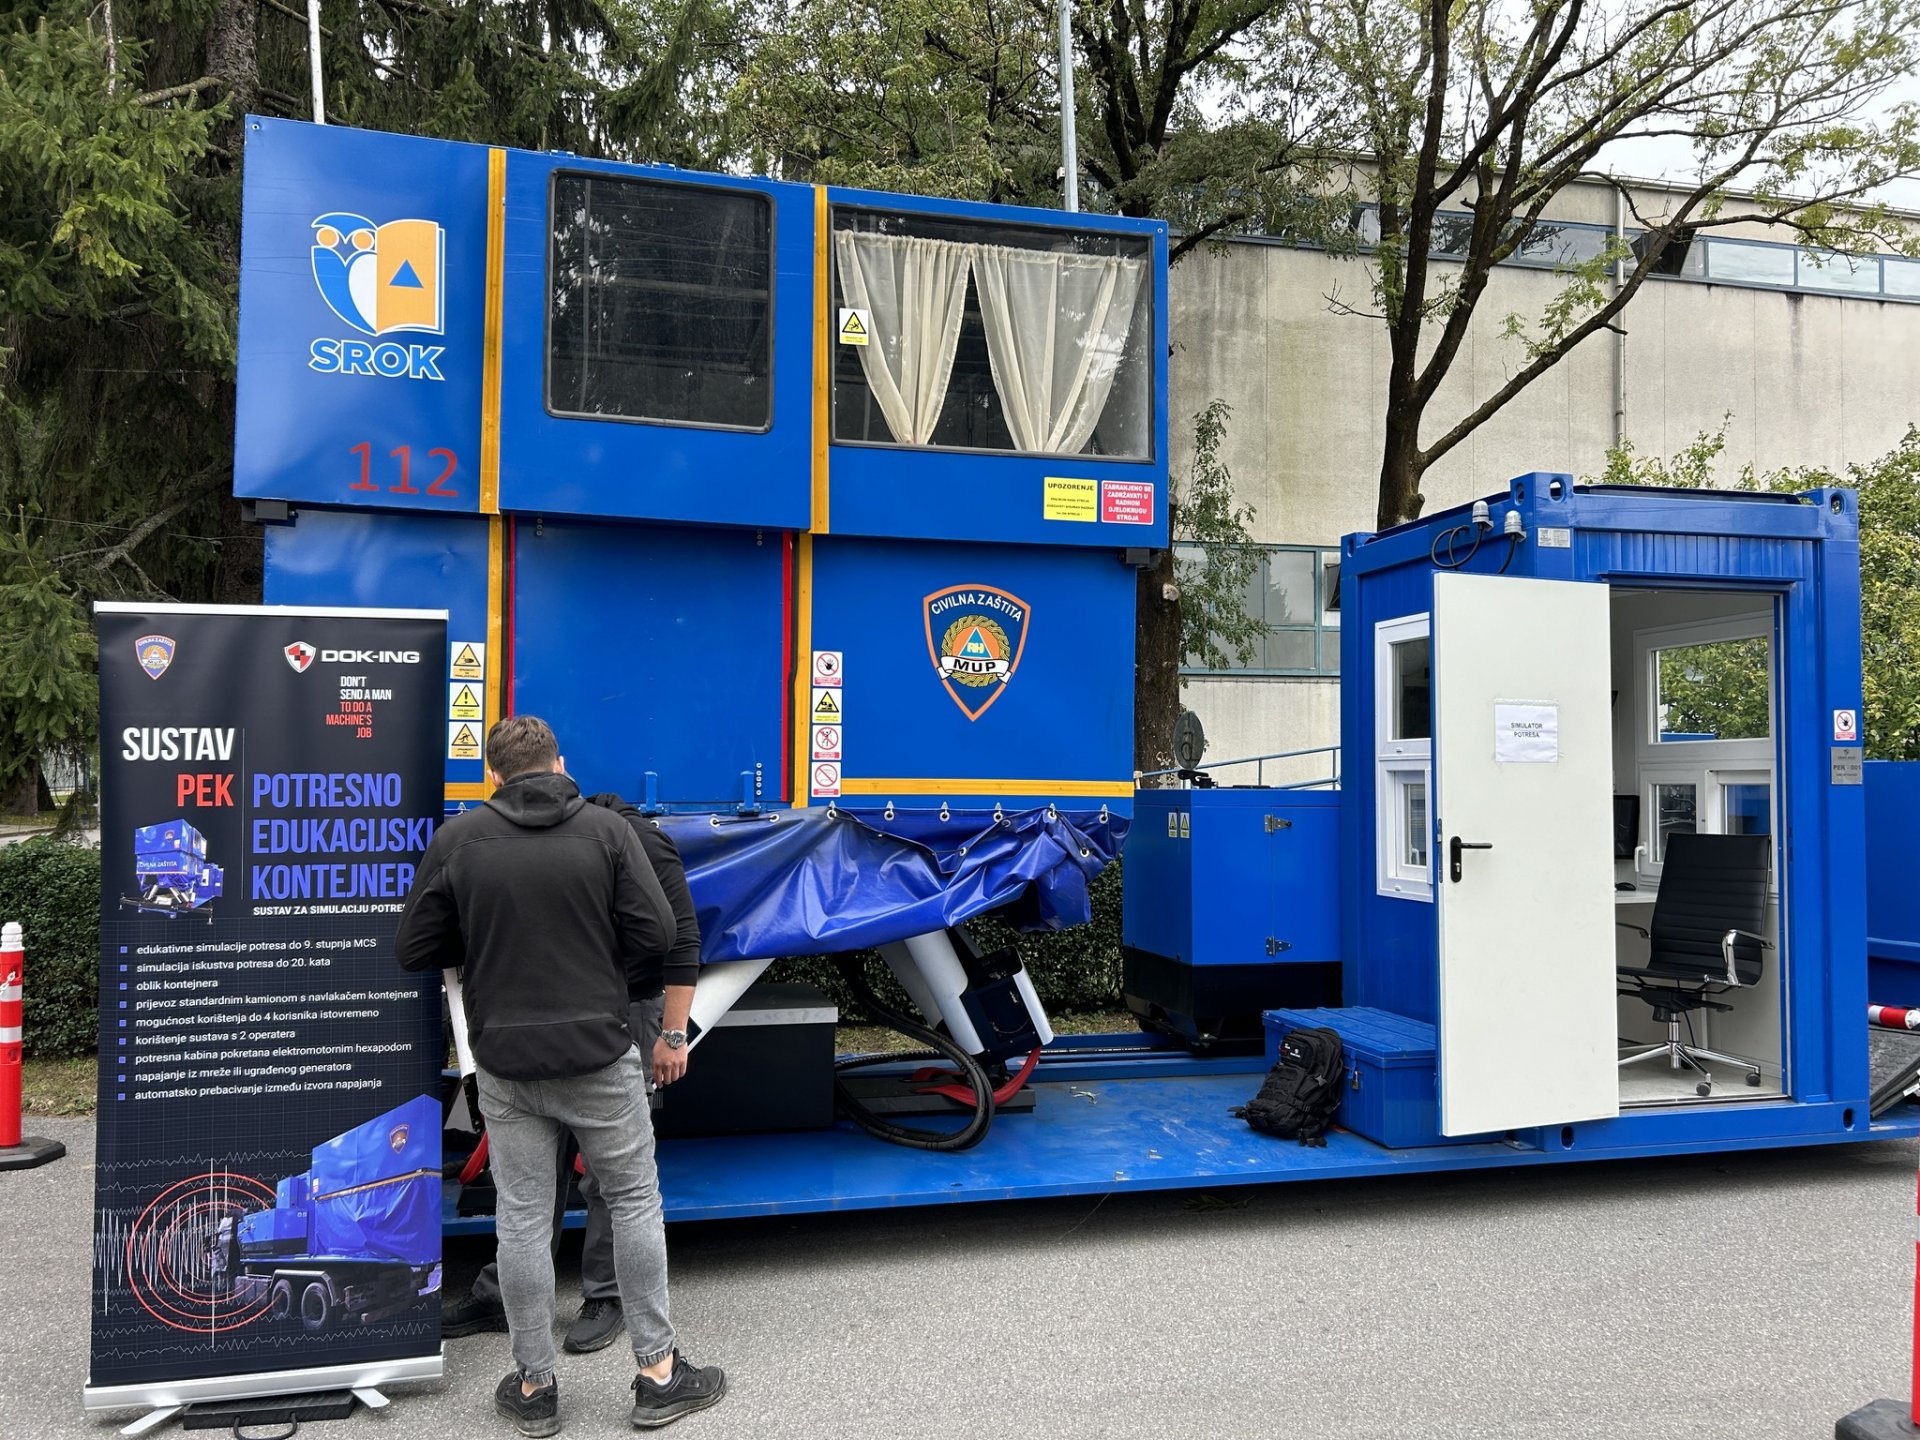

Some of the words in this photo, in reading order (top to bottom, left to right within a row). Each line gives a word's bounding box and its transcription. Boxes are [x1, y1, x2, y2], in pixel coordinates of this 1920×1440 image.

[308, 337, 446, 381] SROK
[349, 441, 458, 496] 112
[1047, 482, 1095, 491] UPOZORENJE
[1107, 491, 1143, 499] ZADRŽAVATI
[1108, 506, 1148, 514] DJELOKRUGU
[931, 594, 975, 614] CIVILNA
[977, 594, 1022, 622] ZAŠTITA
[967, 642, 984, 654] RH
[321, 649, 420, 664] DOK-ING
[953, 659, 996, 672] MUP
[340, 676, 367, 687] DON'T
[340, 689, 363, 700] SEND
[364, 689, 371, 700] A
[372, 689, 392, 700] MAN
[340, 702, 351, 712] TO
[353, 702, 364, 712] DO
[366, 702, 373, 712] A
[326, 714, 372, 725] MACHINE'S
[356, 727, 372, 738] JOB
[122, 727, 236, 762] SUSTAV
[177, 773, 234, 807] PEK
[253, 773, 402, 808] POTRESNO
[253, 818, 434, 854] EDUKACIJSKI
[253, 864, 415, 900] KONTEJNER
[253, 906, 292, 916] SUSTAV
[294, 905, 308, 915] ZA
[310, 904, 369, 915] SIMULACIJU
[136, 944, 193, 955] edukativne
[195, 942, 247, 953] simulacije
[249, 942, 287, 952] potresa
[289, 940, 301, 950] do
[303, 940, 313, 949] 9.
[315, 939, 352, 950] stupnja
[353, 938, 377, 948] MCS
[136, 961, 190, 973] simulacija
[191, 960, 234, 971] iskustva
[236, 959, 274, 971] potresa
[276, 958, 289, 968] do
[291, 957, 307, 967] 20.
[309, 957, 331, 967] kata
[136, 980, 162, 991] oblik
[163, 978, 219, 990] kontejnera
[136, 998, 177, 1010] prijevoz
[179, 996, 243, 1007] standardnim
[245, 994, 298, 1004] kamionom
[308, 991, 367, 1001] navlakačem
[368, 989, 419, 1001] kontejnera
[136, 1016, 195, 1028] mogućnost
[197, 1012, 247, 1025] korištenja
[249, 1011, 262, 1021] do
[263, 1011, 271, 1021] 4
[272, 1010, 318, 1020] korisnika
[320, 1009, 380, 1019] istovremeno
[135, 1033, 187, 1045] korištenje
[189, 1032, 229, 1042] sustava
[231, 1032, 238, 1040] s
[240, 1030, 247, 1040] 2
[248, 1029, 296, 1041] operatera
[135, 1053, 182, 1066] potresna
[184, 1050, 218, 1061] kabina
[220, 1048, 270, 1061] pokretana
[272, 1044, 354, 1056] elektromotornim
[355, 1041, 412, 1054] hexapodom
[135, 1070, 186, 1083] napajanje
[188, 1069, 198, 1078] iz
[199, 1067, 232, 1077] mreže
[233, 1066, 242, 1076] ili
[244, 1065, 297, 1077] ugrađenog
[299, 1061, 352, 1075] generatora
[134, 1087, 198, 1100] automatsko
[199, 1083, 263, 1097] prebacivanje
[265, 1081, 302, 1093] između
[304, 1081, 333, 1091] izvora
[335, 1078, 382, 1090] napajanja
